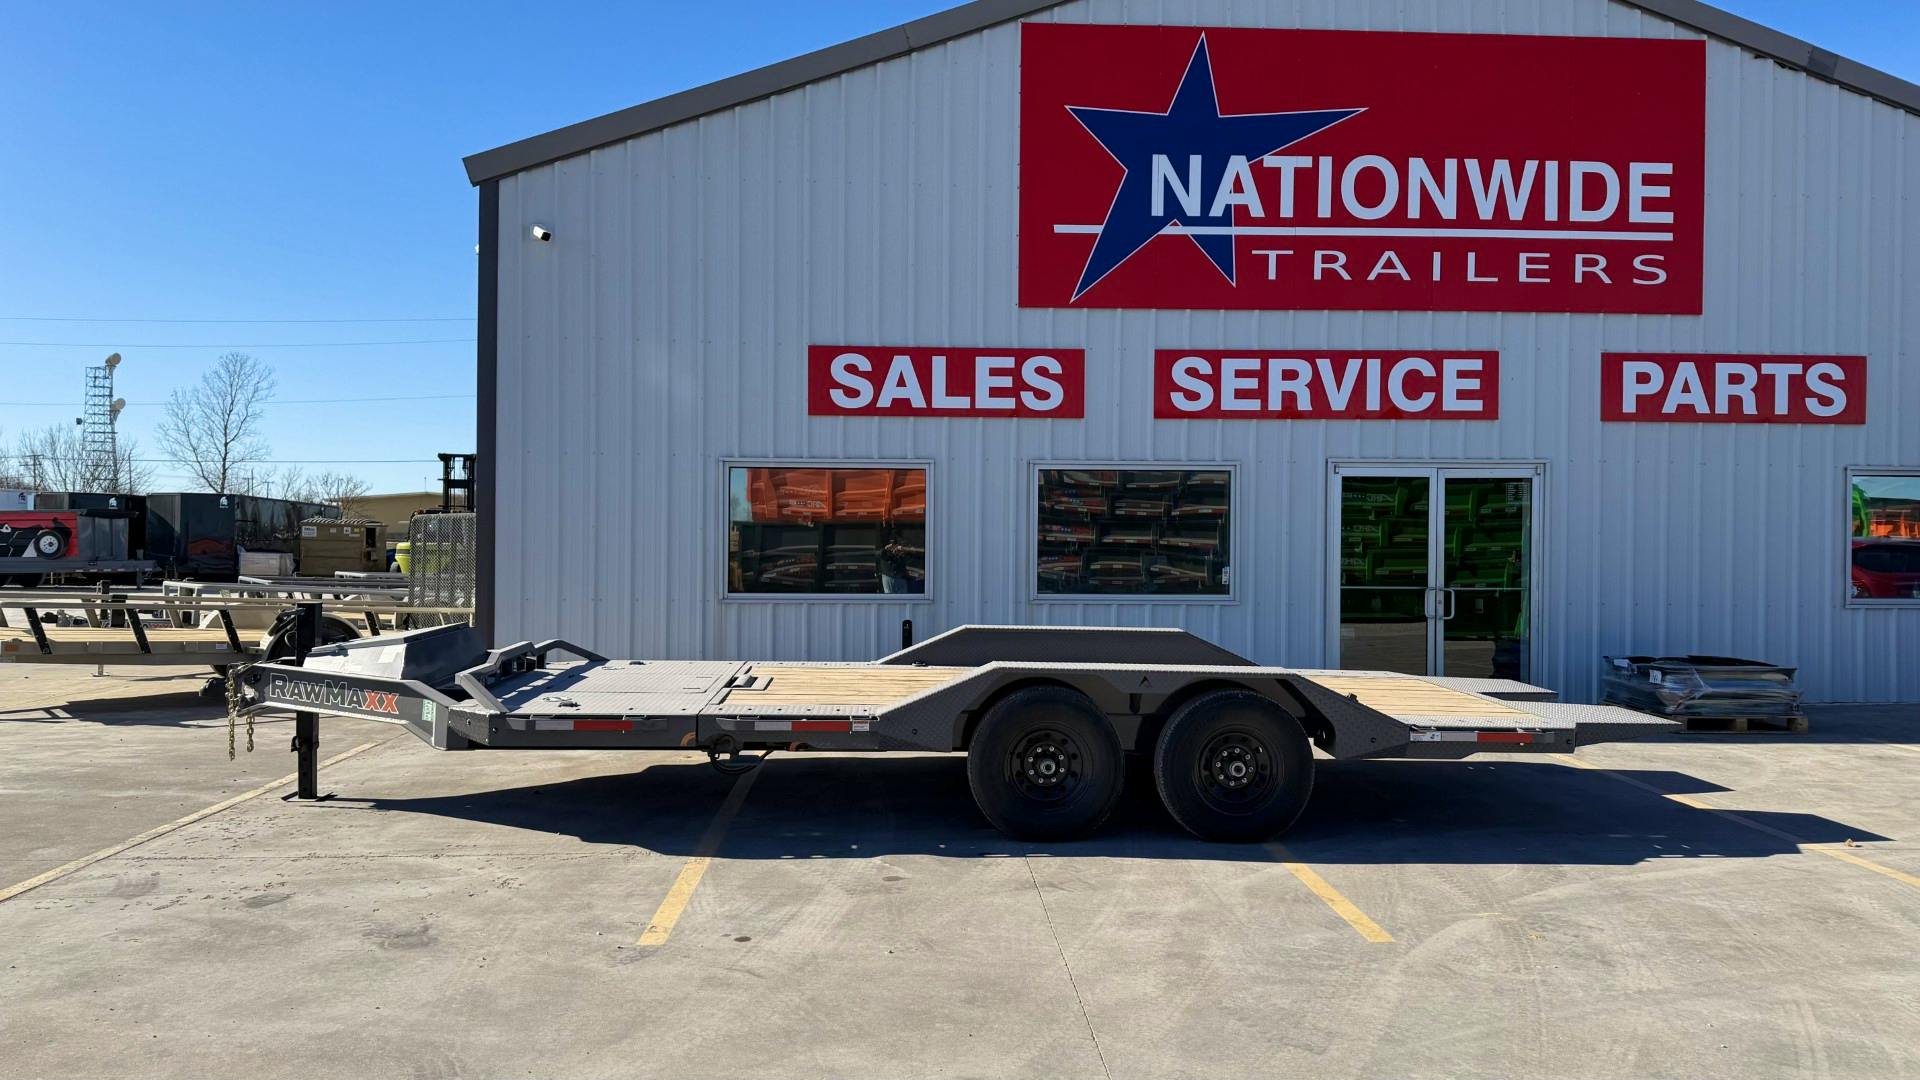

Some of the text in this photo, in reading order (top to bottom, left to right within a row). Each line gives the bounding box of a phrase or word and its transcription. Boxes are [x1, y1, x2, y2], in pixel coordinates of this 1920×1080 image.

[1151, 153, 1675, 224] NATIONWIDE
[1251, 249, 1668, 285] TRAILERS
[829, 353, 1064, 411] SALES
[1170, 356, 1484, 413] SERVICE
[1621, 361, 1848, 417] PARTS
